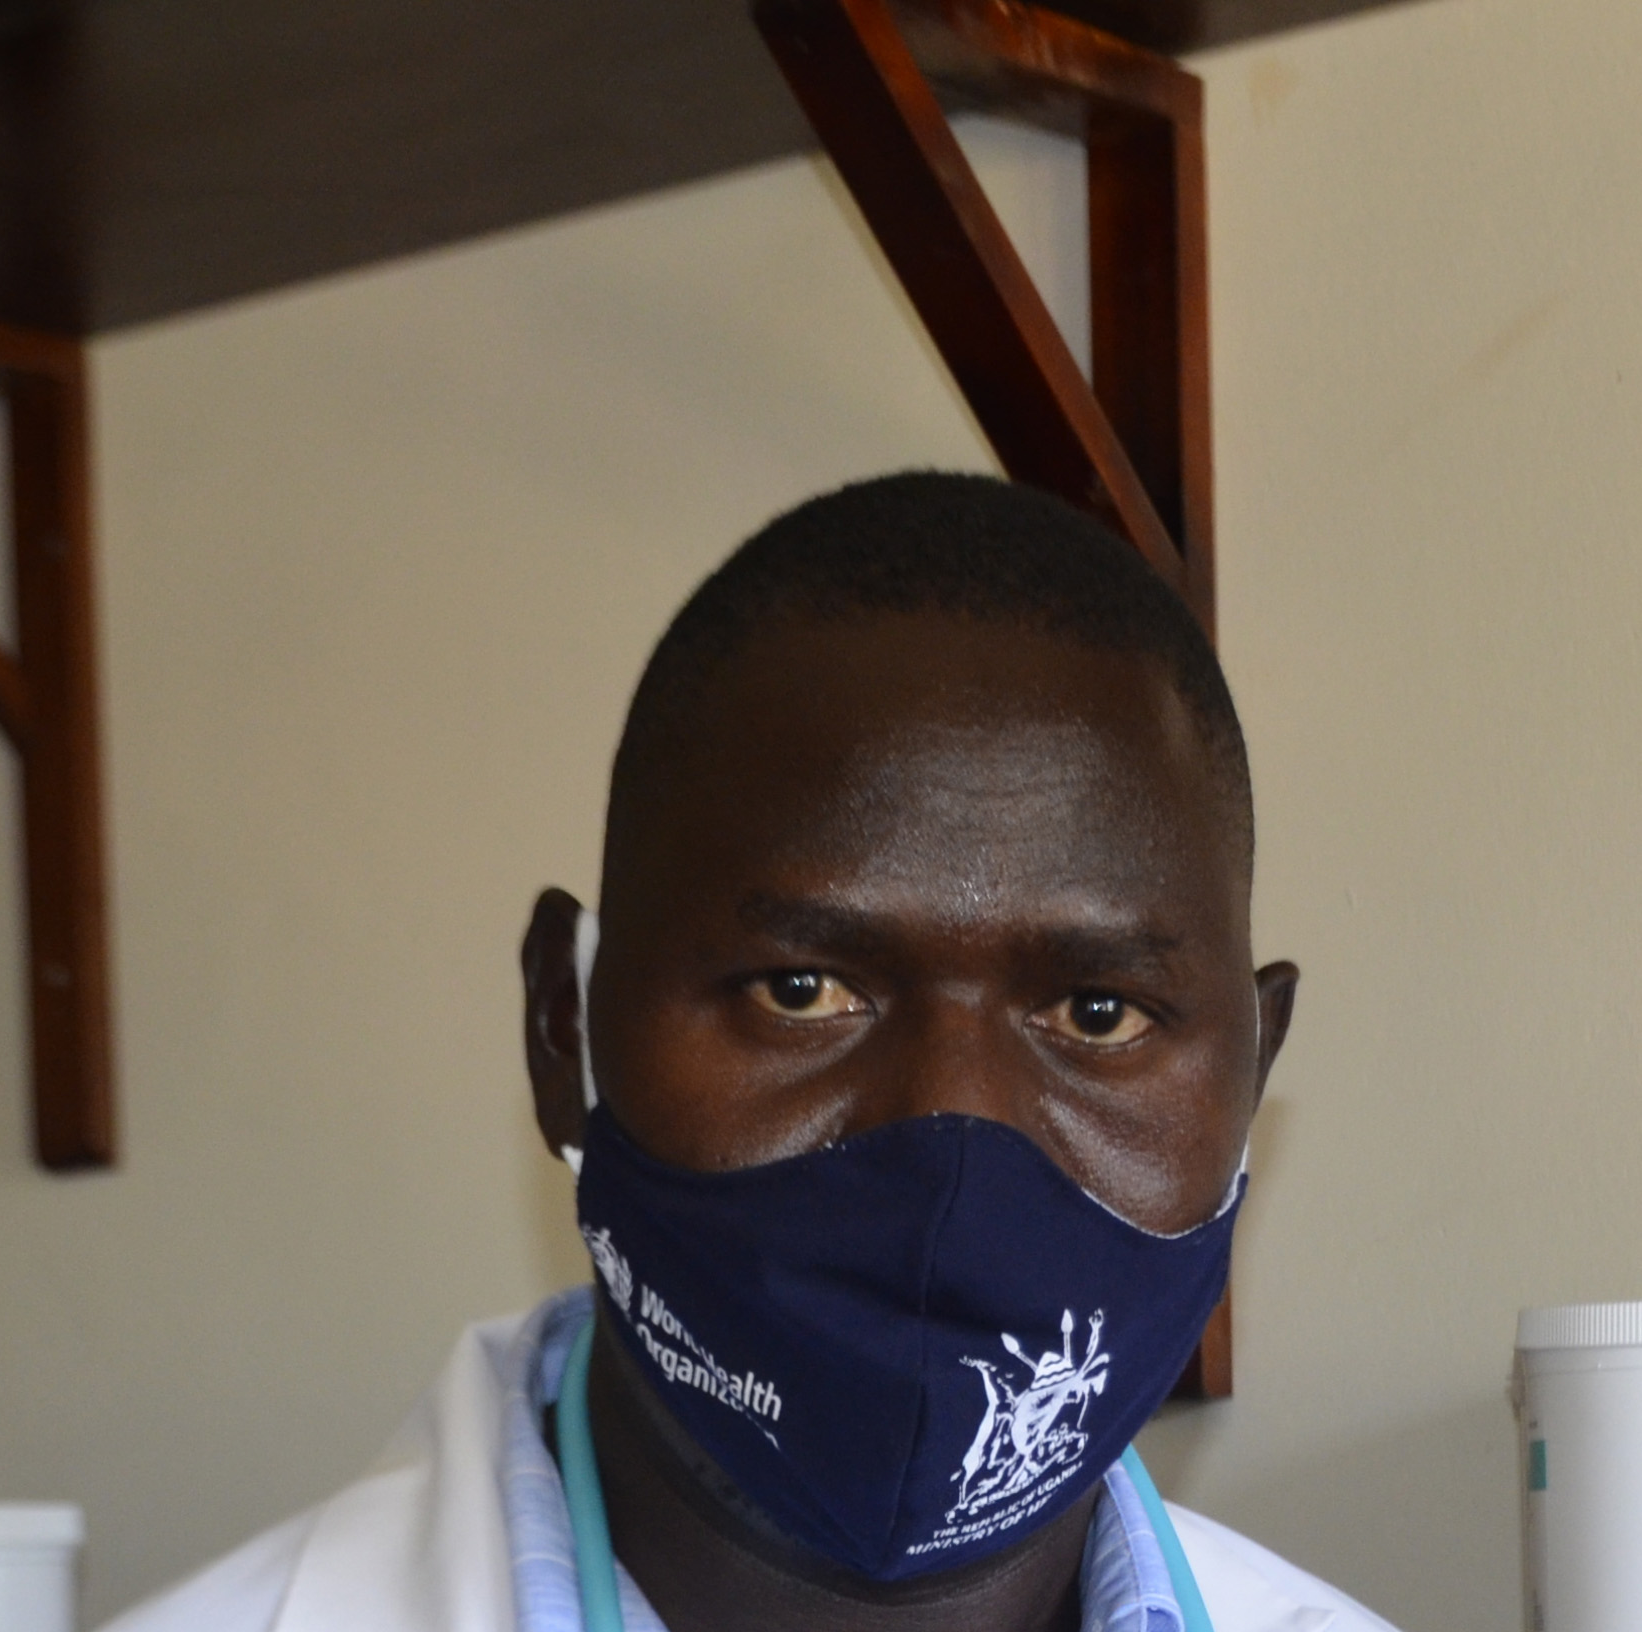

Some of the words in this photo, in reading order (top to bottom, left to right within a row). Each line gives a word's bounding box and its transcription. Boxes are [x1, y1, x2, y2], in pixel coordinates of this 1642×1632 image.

[906, 1522, 1000, 1555] MINISTRY
[1000, 1509, 1026, 1530] OF
[933, 1526, 959, 1540] THE
